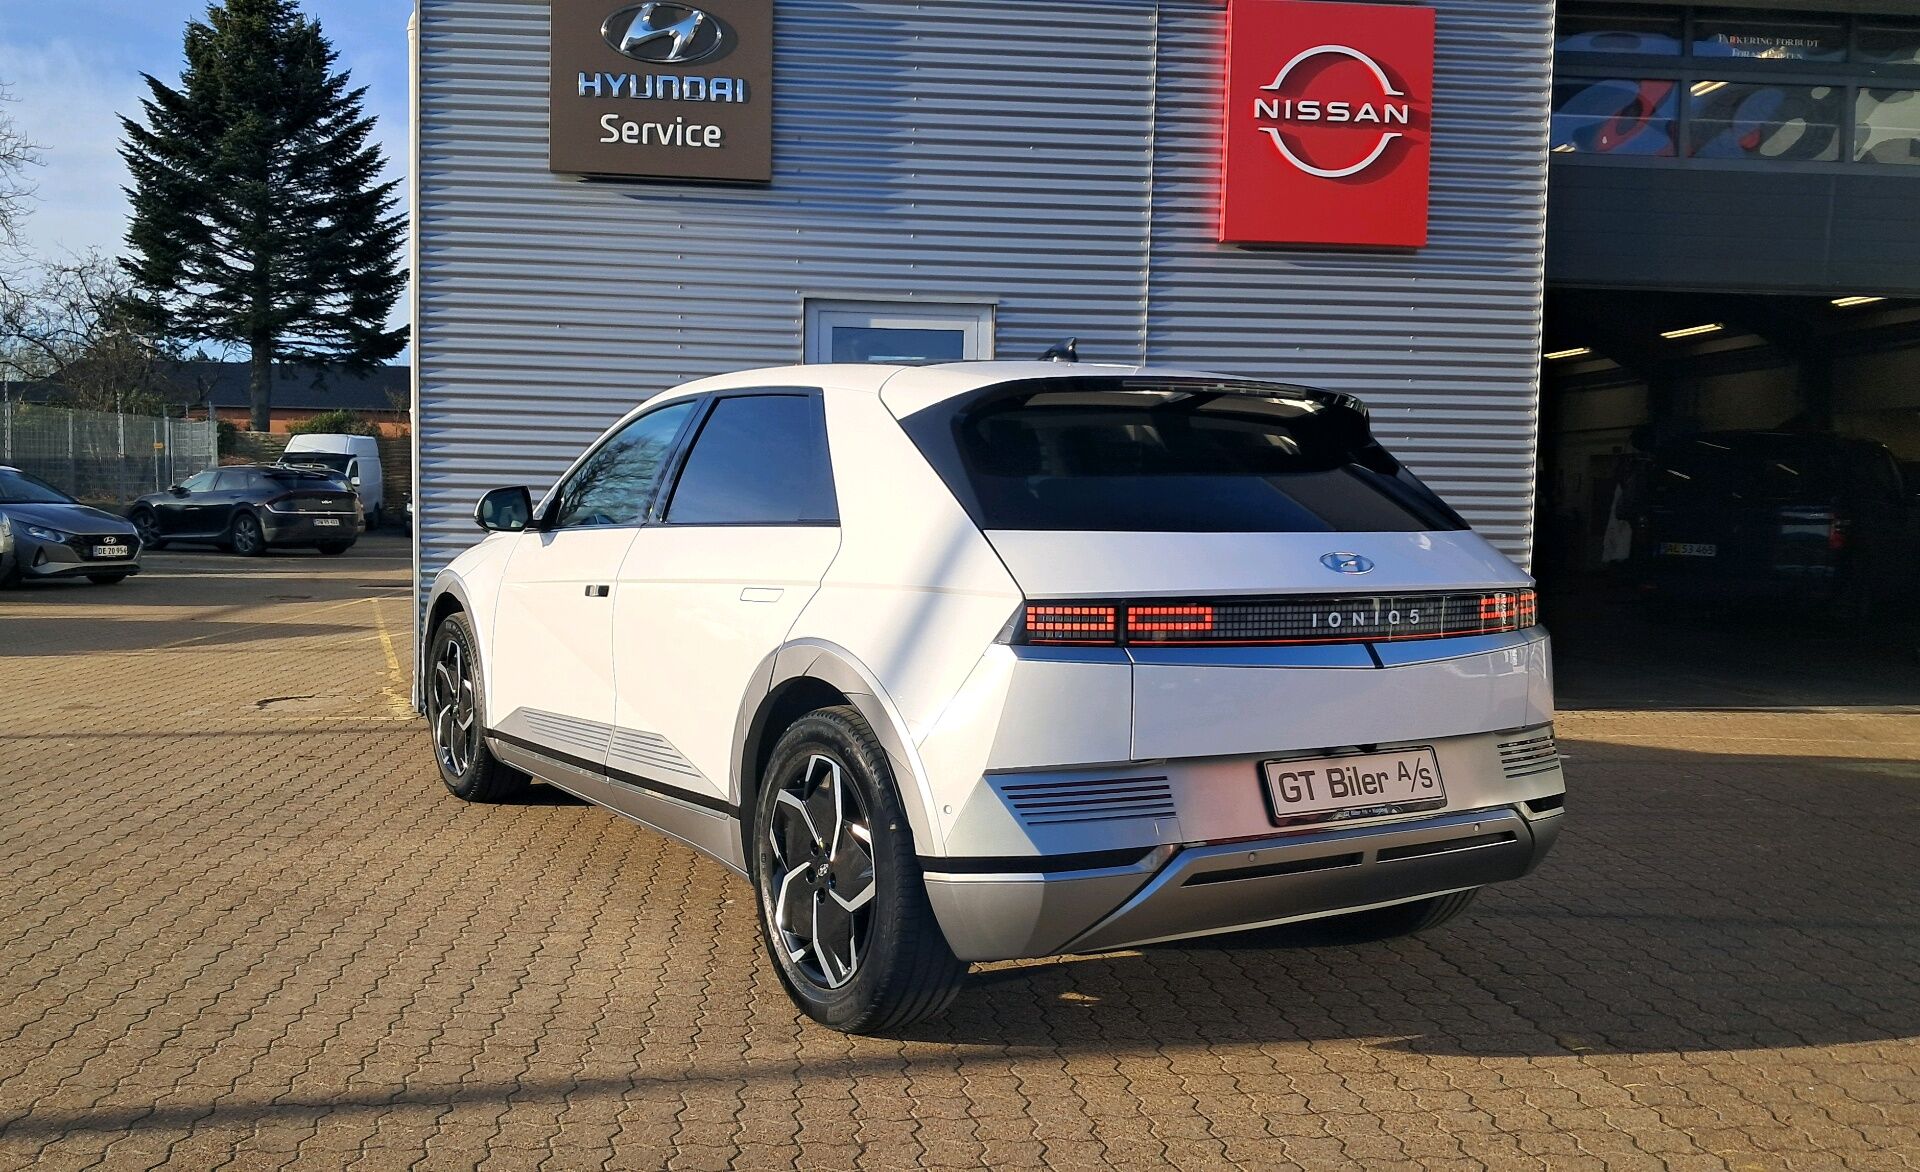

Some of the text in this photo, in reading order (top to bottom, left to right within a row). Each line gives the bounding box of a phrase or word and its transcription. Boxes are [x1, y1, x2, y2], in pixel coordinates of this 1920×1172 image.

[578, 72, 744, 103] HYUNDAI
[1254, 98, 1409, 124] NISSAN
[600, 113, 722, 148] Service
[98, 547, 107, 555] DE
[1312, 609, 1420, 628] IONIQ 5
[1278, 770, 1316, 803] GT
[1326, 766, 1389, 799] Biler
